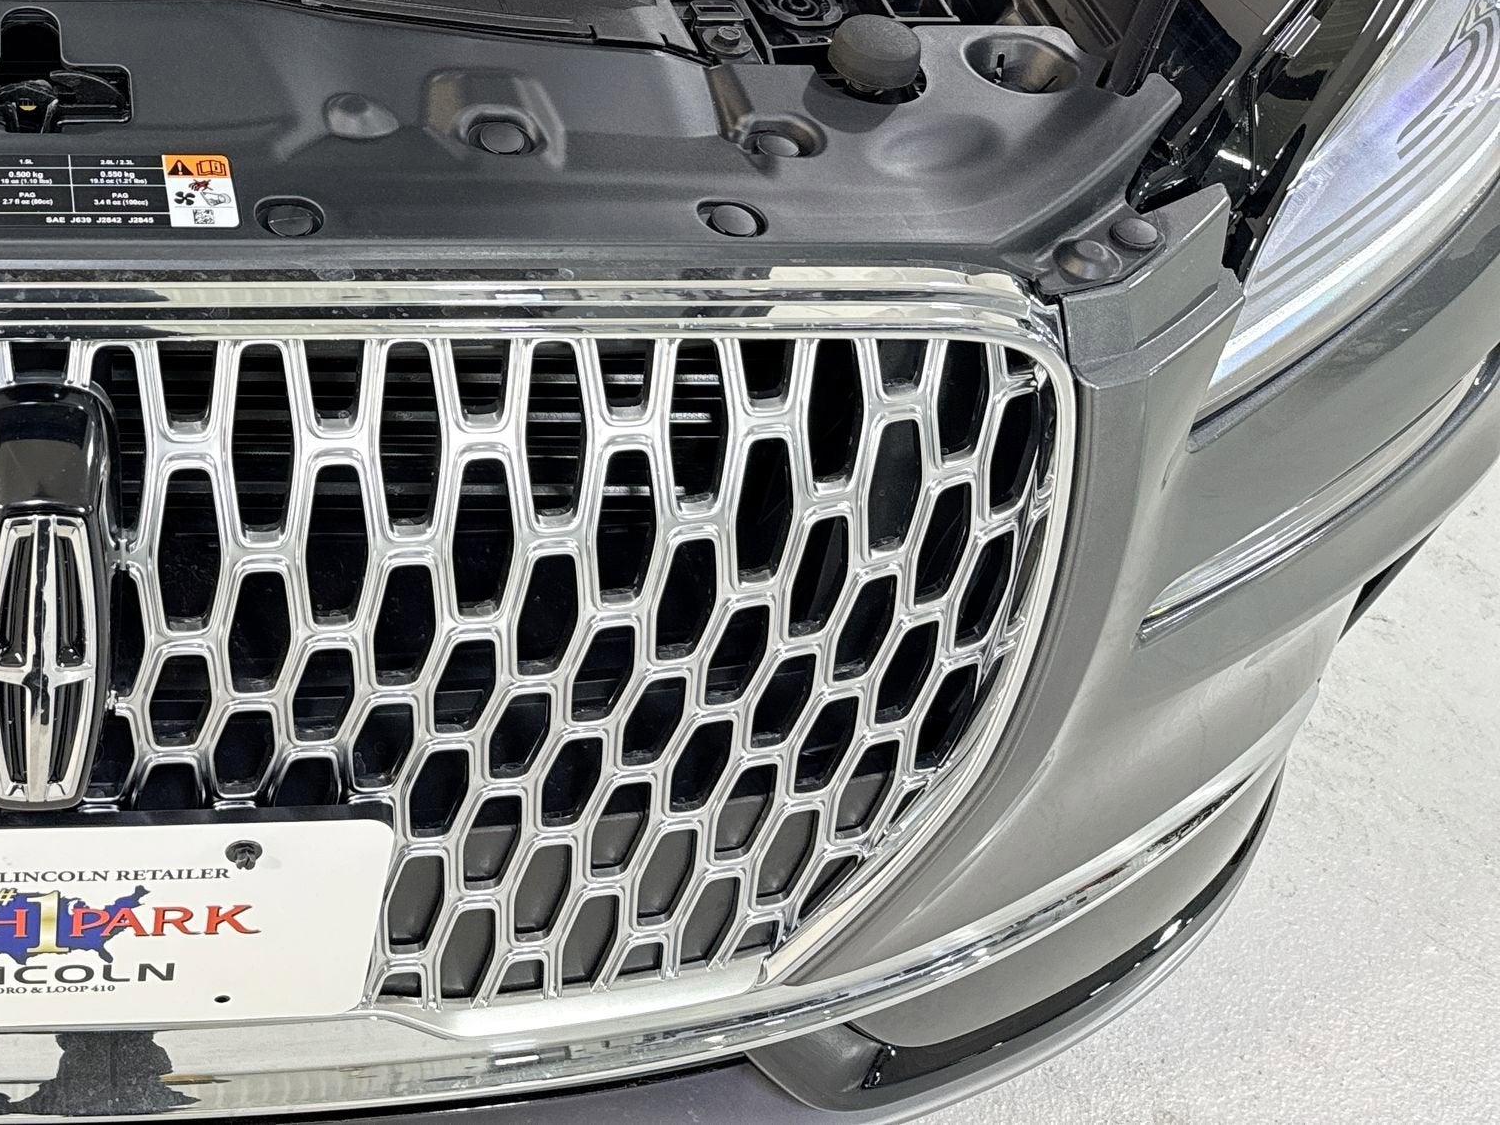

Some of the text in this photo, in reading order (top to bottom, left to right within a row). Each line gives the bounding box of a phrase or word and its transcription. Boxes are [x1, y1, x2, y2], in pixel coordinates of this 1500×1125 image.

[32, 171, 44, 180] kg
[124, 171, 136, 180] kg
[93, 198, 105, 206] 3.4
[45, 216, 155, 224] SAE J639 J2842 J2845
[115, 868, 230, 881] RETAILER
[68, 904, 262, 938] PARK
[30, 986, 44, 994] &
[46, 985, 90, 994] LOOP
[92, 984, 116, 993] 410
